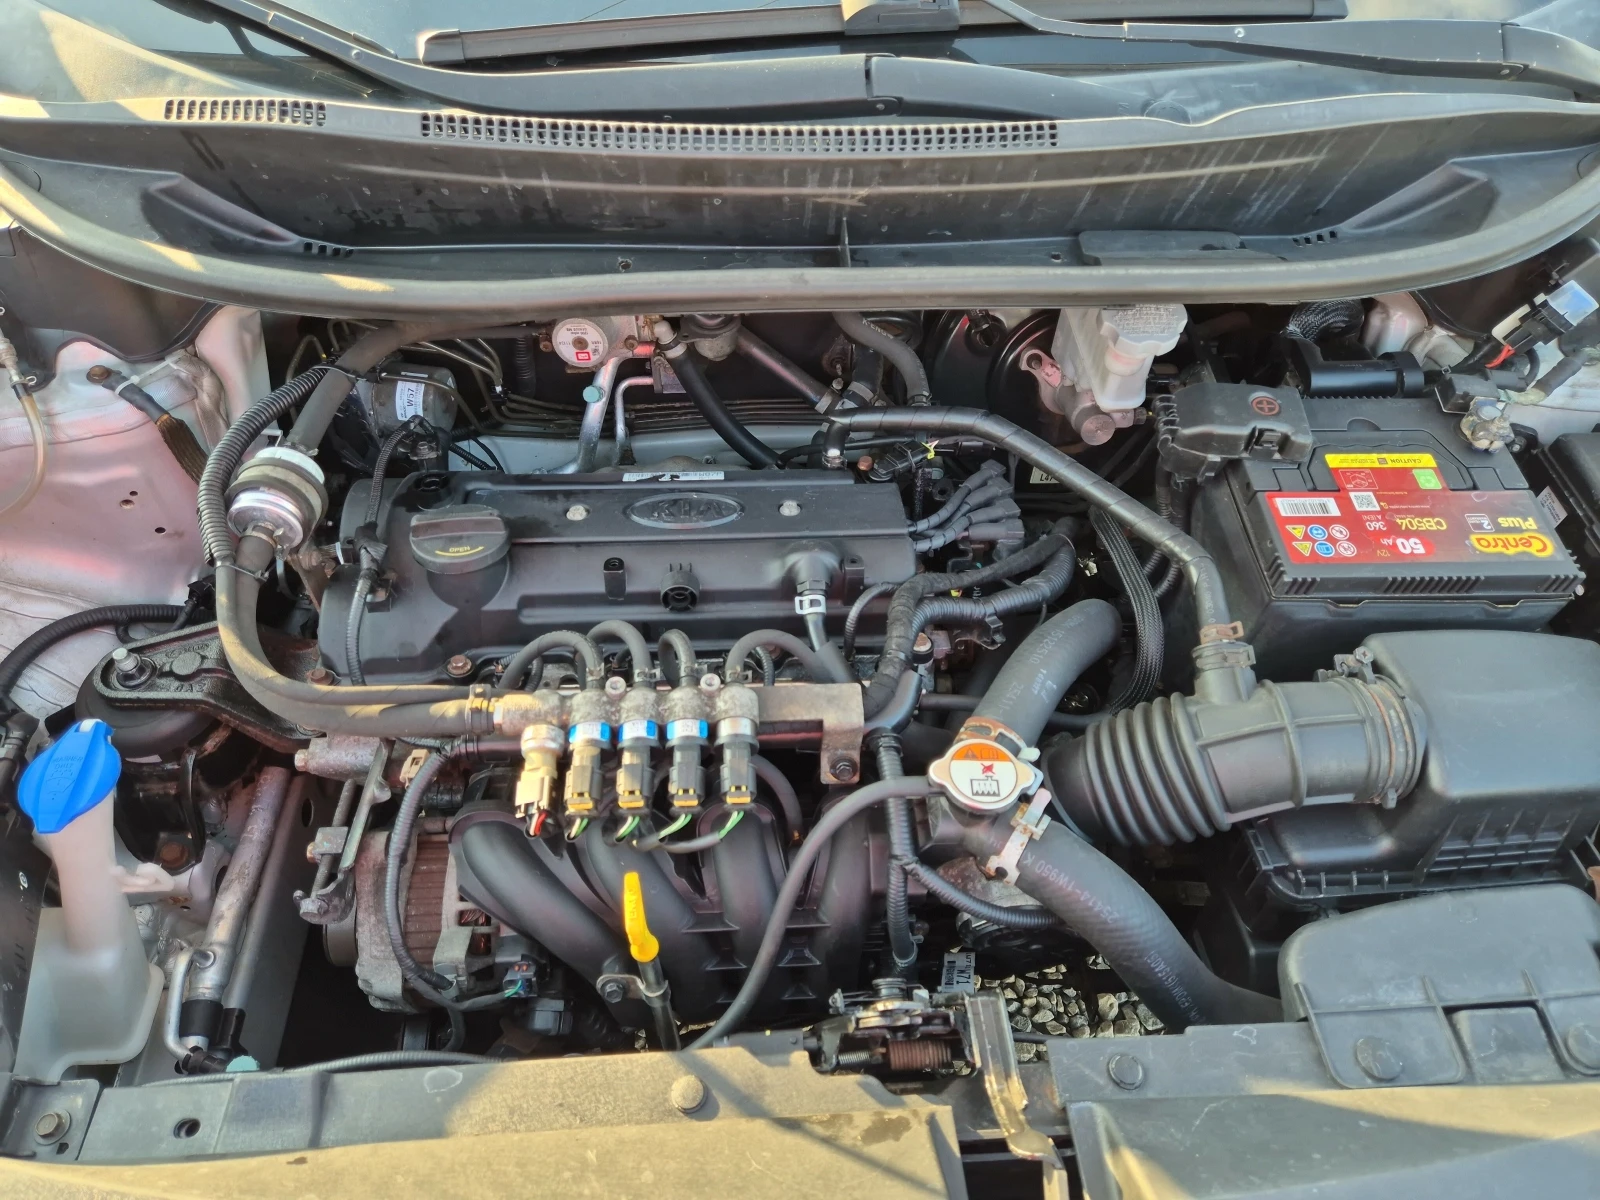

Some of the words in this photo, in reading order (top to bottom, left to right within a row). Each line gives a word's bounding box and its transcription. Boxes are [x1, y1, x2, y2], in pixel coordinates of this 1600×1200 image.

[406, 388, 415, 407] W57
[651, 498, 725, 520] KIA
[1365, 521, 1387, 531] 360
[1396, 517, 1447, 531] CB504
[1480, 519, 1492, 530] 2
[1497, 516, 1538, 530] Plus
[449, 545, 471, 553] OPEN
[1380, 538, 1393, 546] Ah
[1396, 537, 1426, 554] 50
[1475, 535, 1548, 553] Centra
[1376, 549, 1391, 557] 12V
